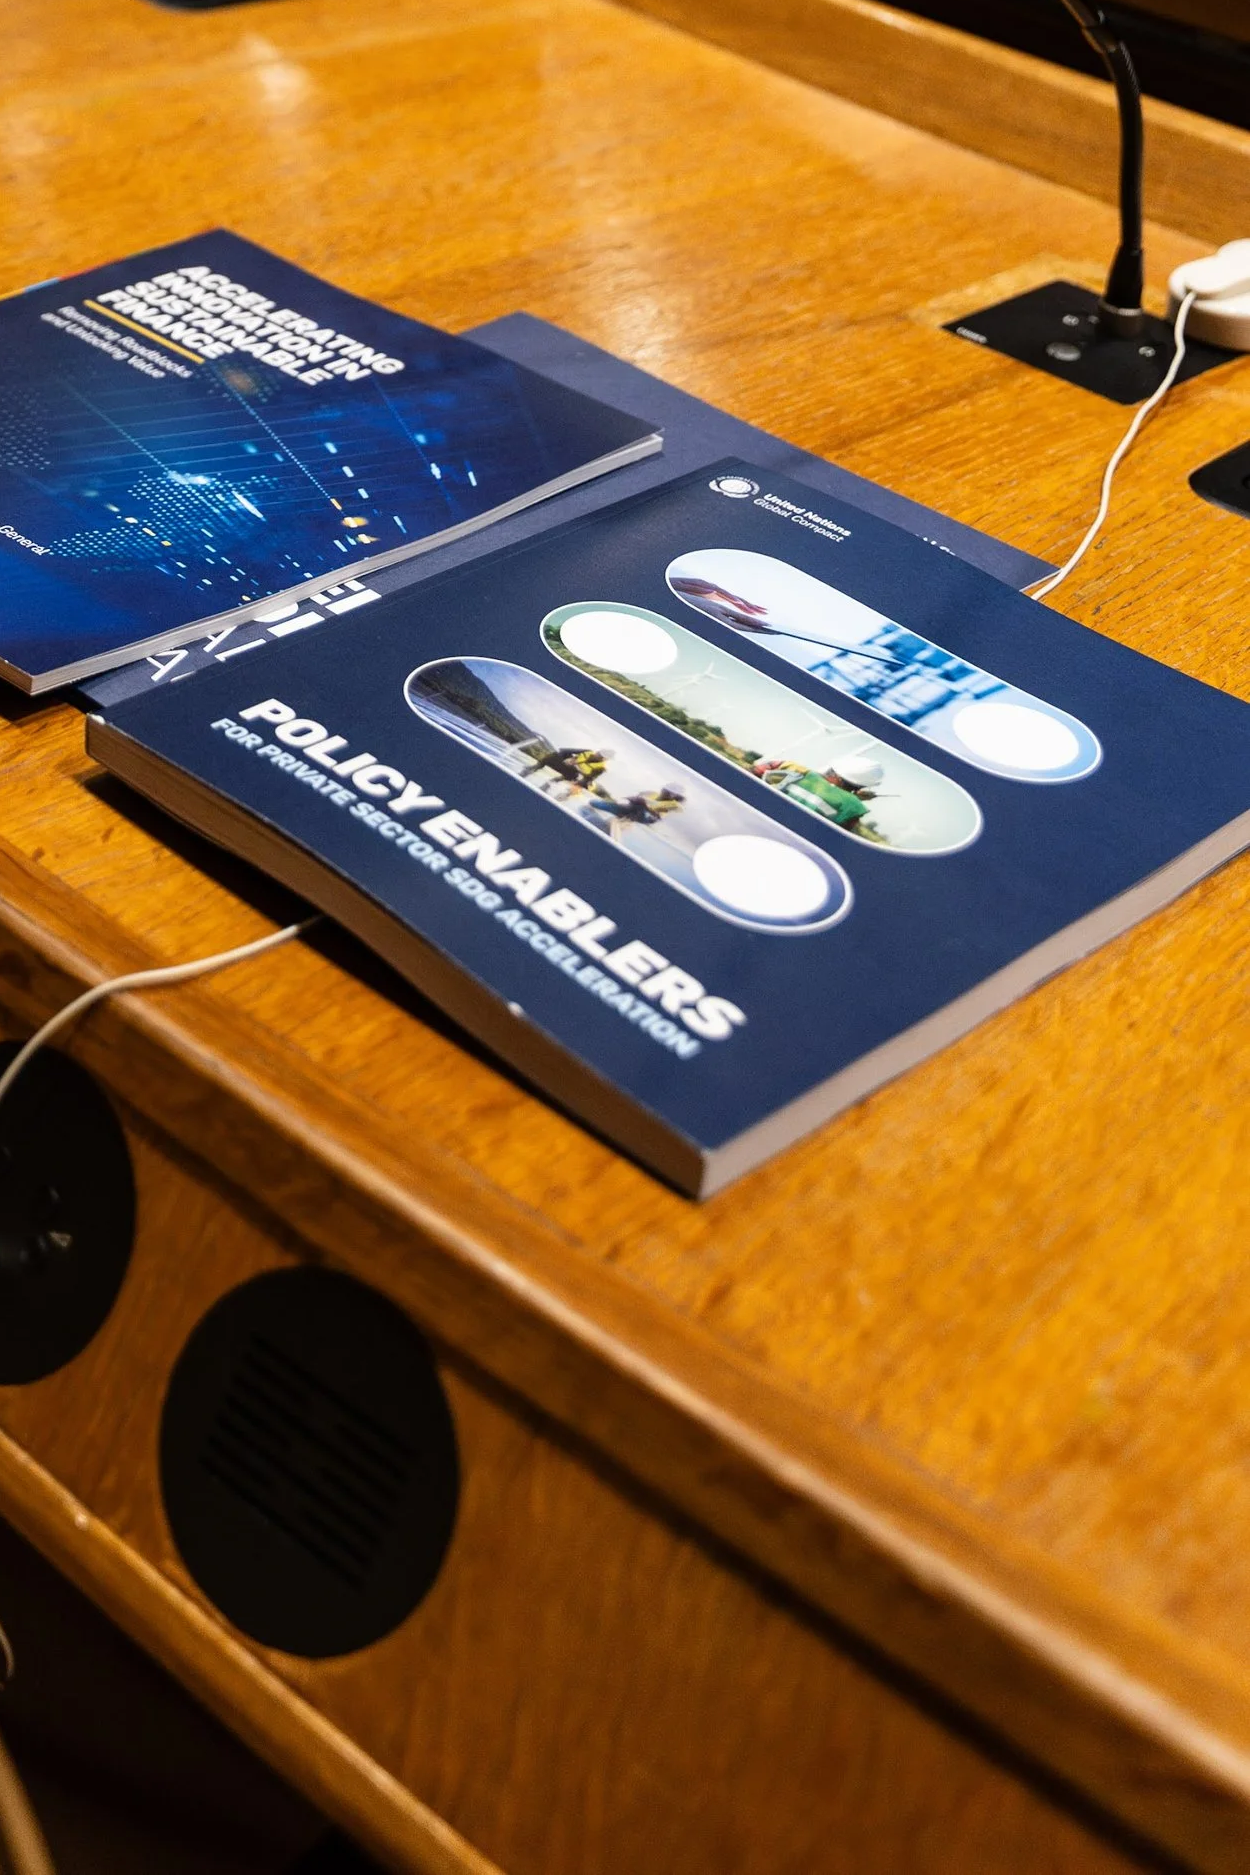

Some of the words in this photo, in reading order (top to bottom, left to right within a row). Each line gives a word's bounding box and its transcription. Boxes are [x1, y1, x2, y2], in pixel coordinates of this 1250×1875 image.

[40, 312, 72, 328] and
[65, 323, 130, 361] Unlocking
[127, 355, 166, 378] Value
[57, 306, 122, 341] Removing
[117, 336, 194, 378] Roadblocks
[96, 288, 235, 359] FINANCE
[125, 280, 334, 386] SUSTAINABLE
[152, 272, 335, 364] INNOVATION
[323, 357, 372, 381] IN
[177, 265, 405, 374] ACCELERATING
[753, 498, 792, 518] Global
[791, 515, 845, 543] Compact
[763, 493, 806, 514] United
[803, 511, 851, 537] Nations
[210, 717, 264, 750] FOR
[256, 744, 359, 807] PRIVATE
[349, 801, 451, 872] SECTOR
[443, 867, 504, 911] SDG
[494, 908, 702, 1060] ACCELERATION
[238, 698, 446, 815] POLICY
[419, 809, 748, 1041] ENABLERS
